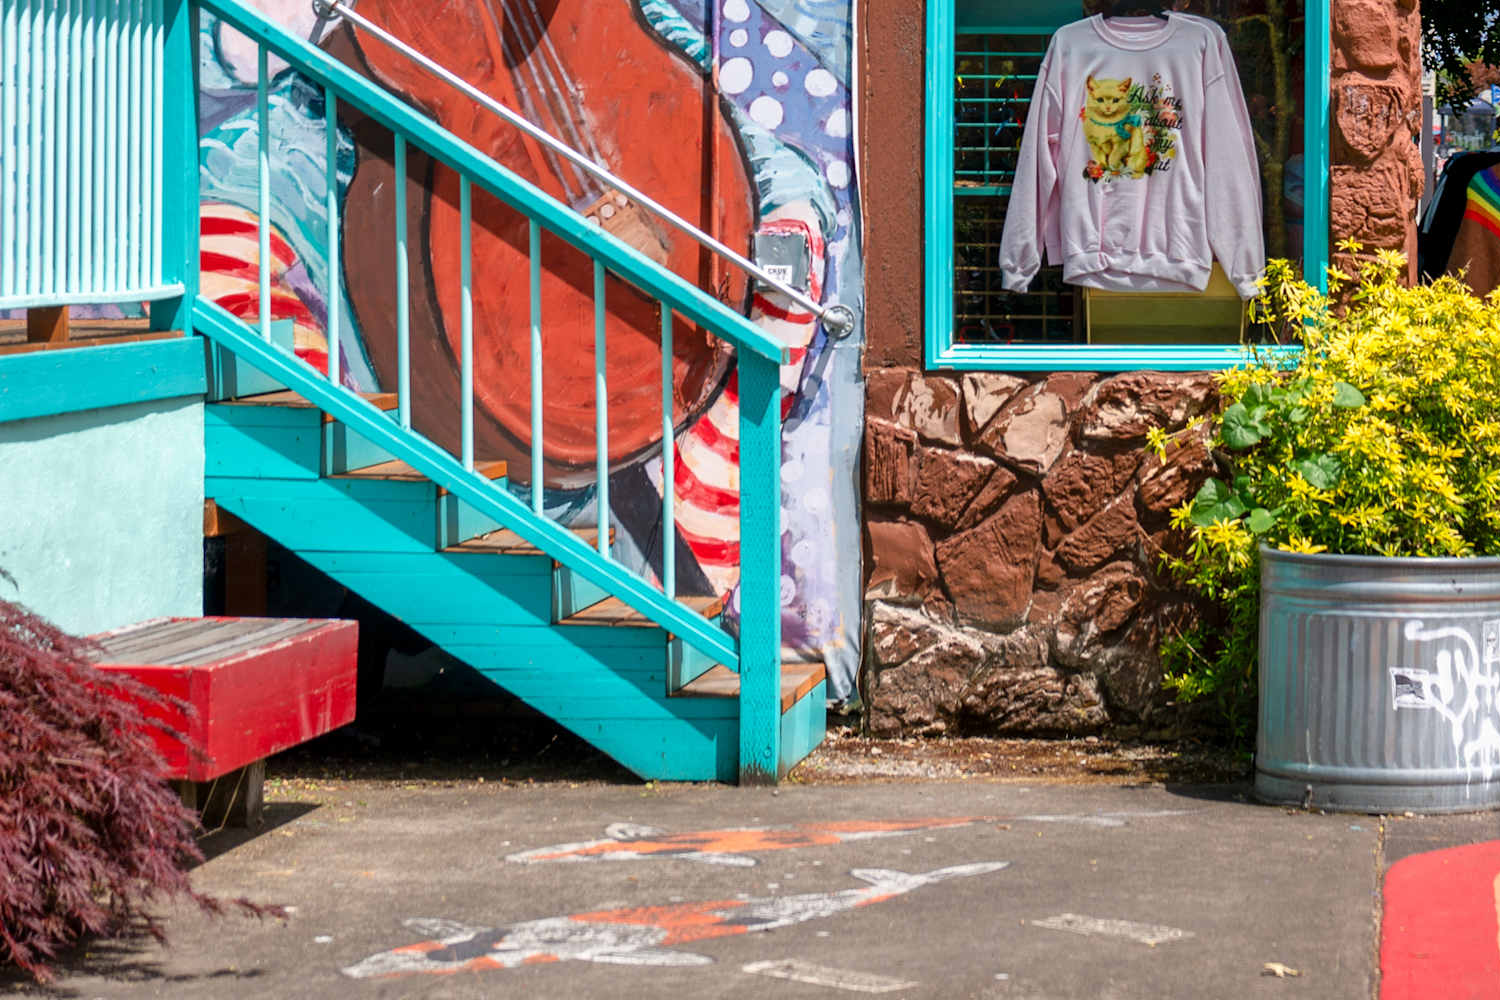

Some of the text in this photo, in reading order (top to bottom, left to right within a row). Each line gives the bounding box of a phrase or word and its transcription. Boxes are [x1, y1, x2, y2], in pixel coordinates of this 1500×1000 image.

[1127, 85, 1183, 110] Ask me
[1144, 112, 1182, 130] about
